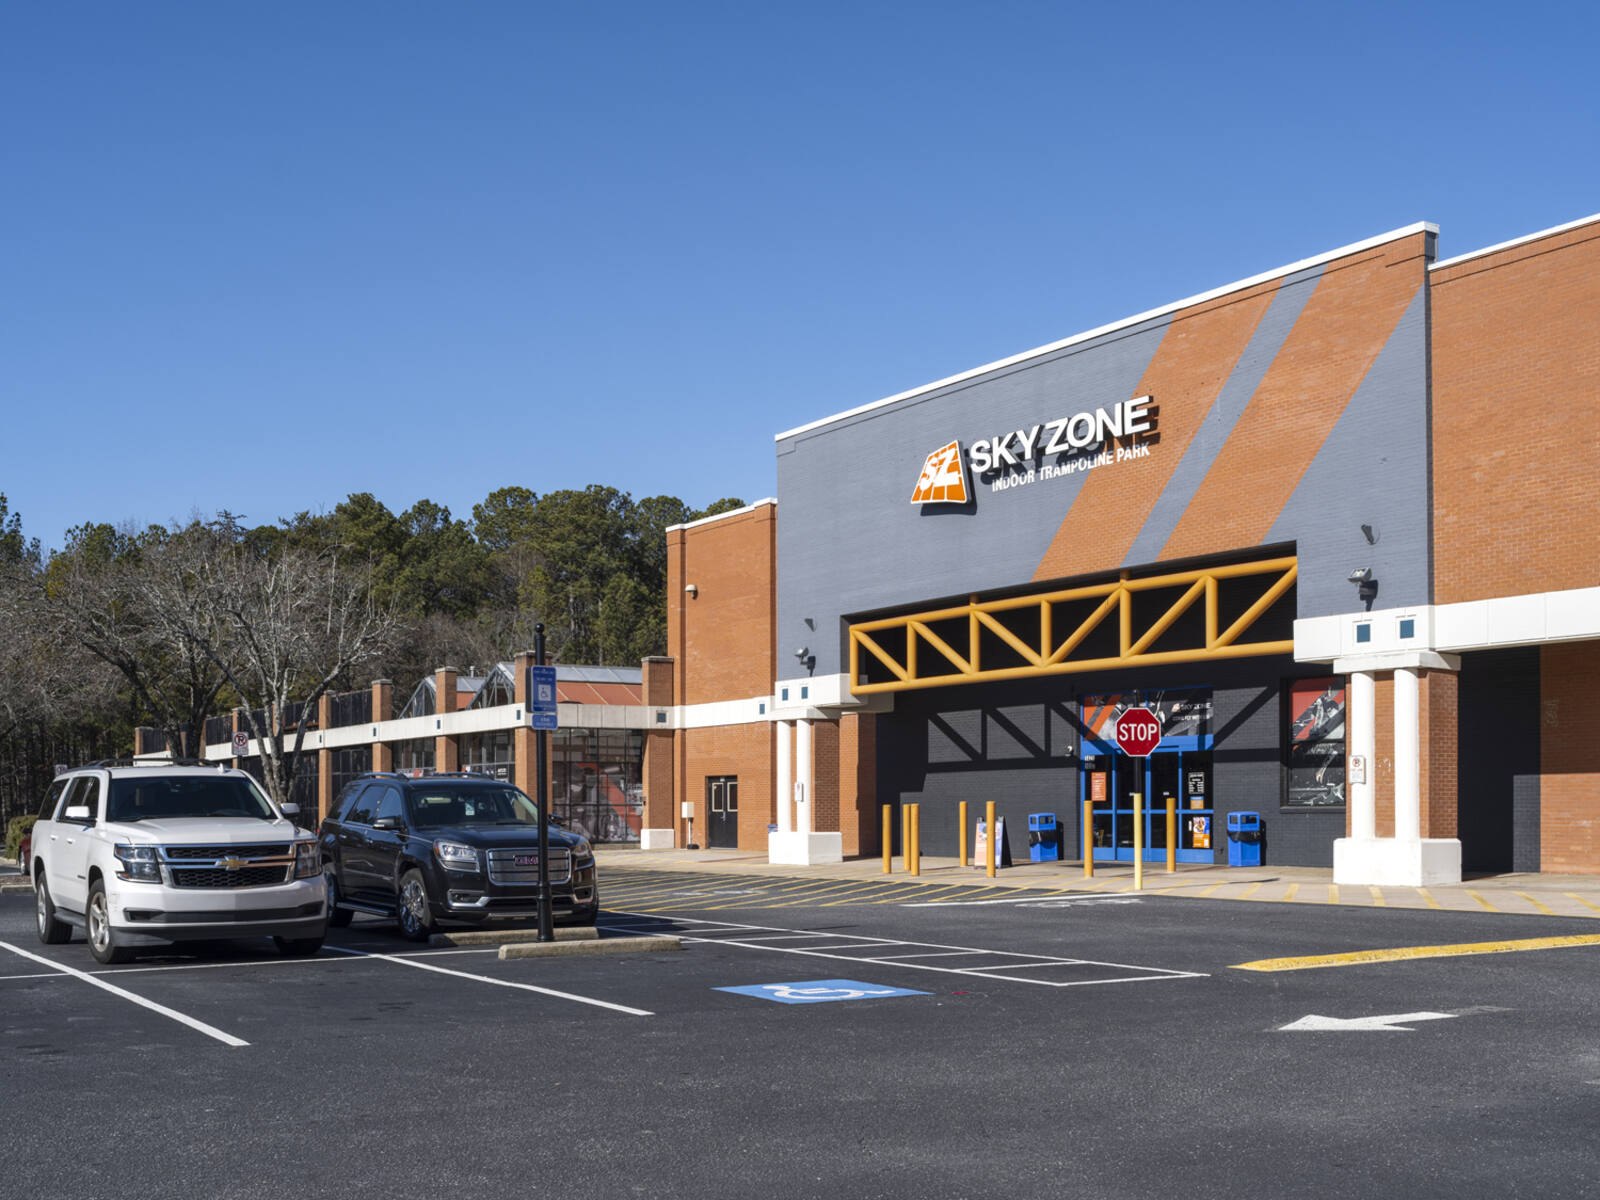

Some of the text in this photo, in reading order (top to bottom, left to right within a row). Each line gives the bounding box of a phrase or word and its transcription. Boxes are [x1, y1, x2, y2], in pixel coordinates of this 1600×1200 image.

[970, 395, 1151, 473] SKY ZONE
[919, 446, 960, 491] SZ
[991, 442, 1151, 493] INDOOR TRAMPOLINE PARK
[1118, 723, 1158, 741] STOP
